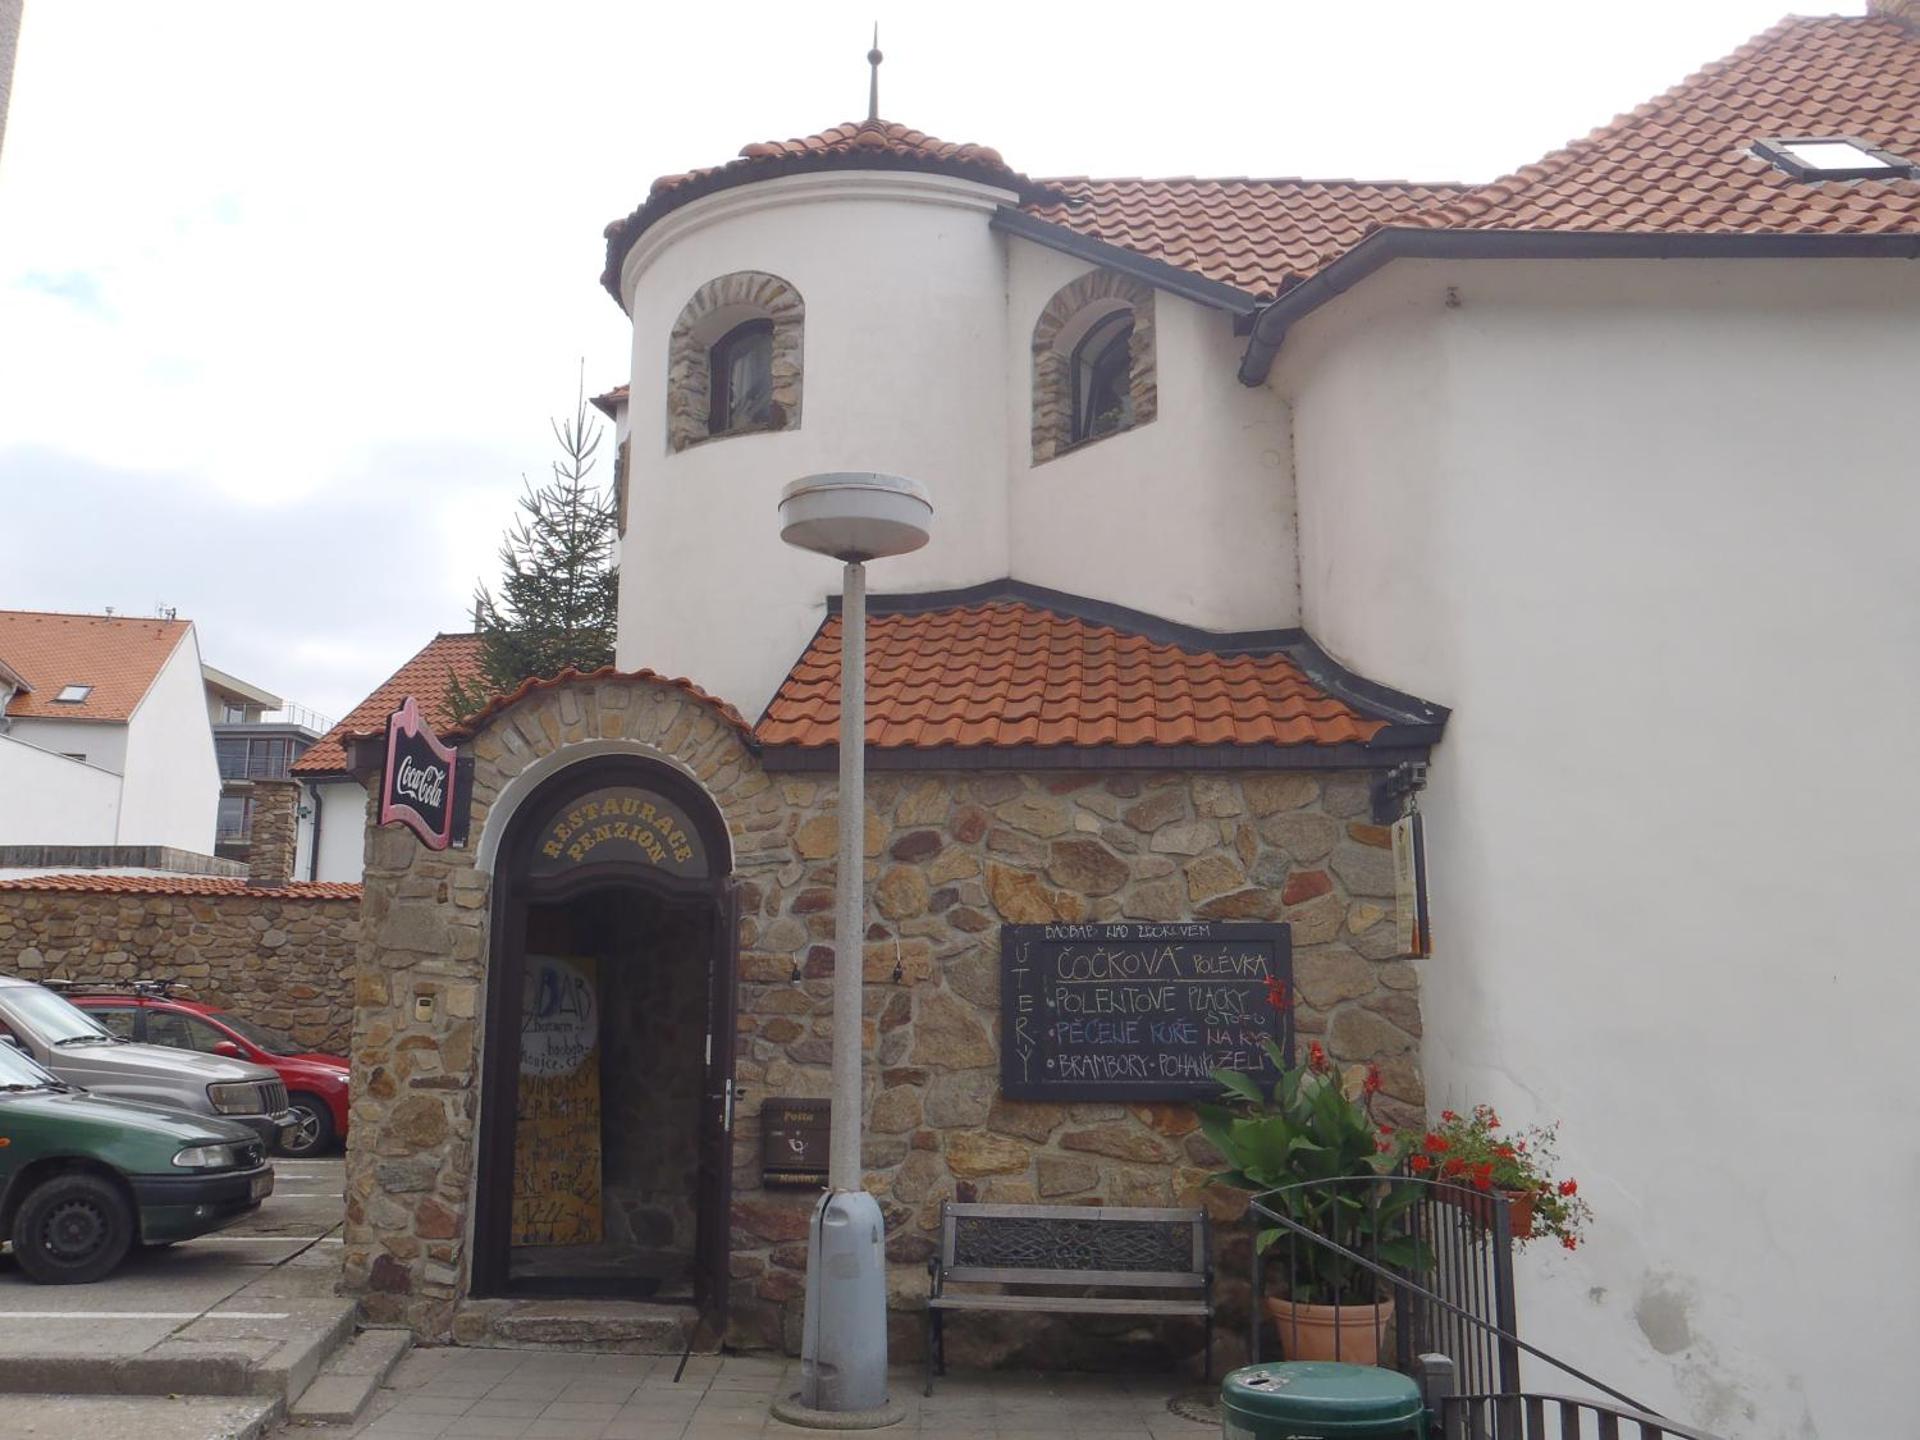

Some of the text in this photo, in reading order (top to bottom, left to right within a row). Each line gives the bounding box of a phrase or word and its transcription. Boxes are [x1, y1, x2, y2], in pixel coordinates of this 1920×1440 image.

[542, 797, 694, 863] RESTAURACE
[566, 821, 667, 864] PENZION
[1059, 1053, 1149, 1080] BRAMBORY
